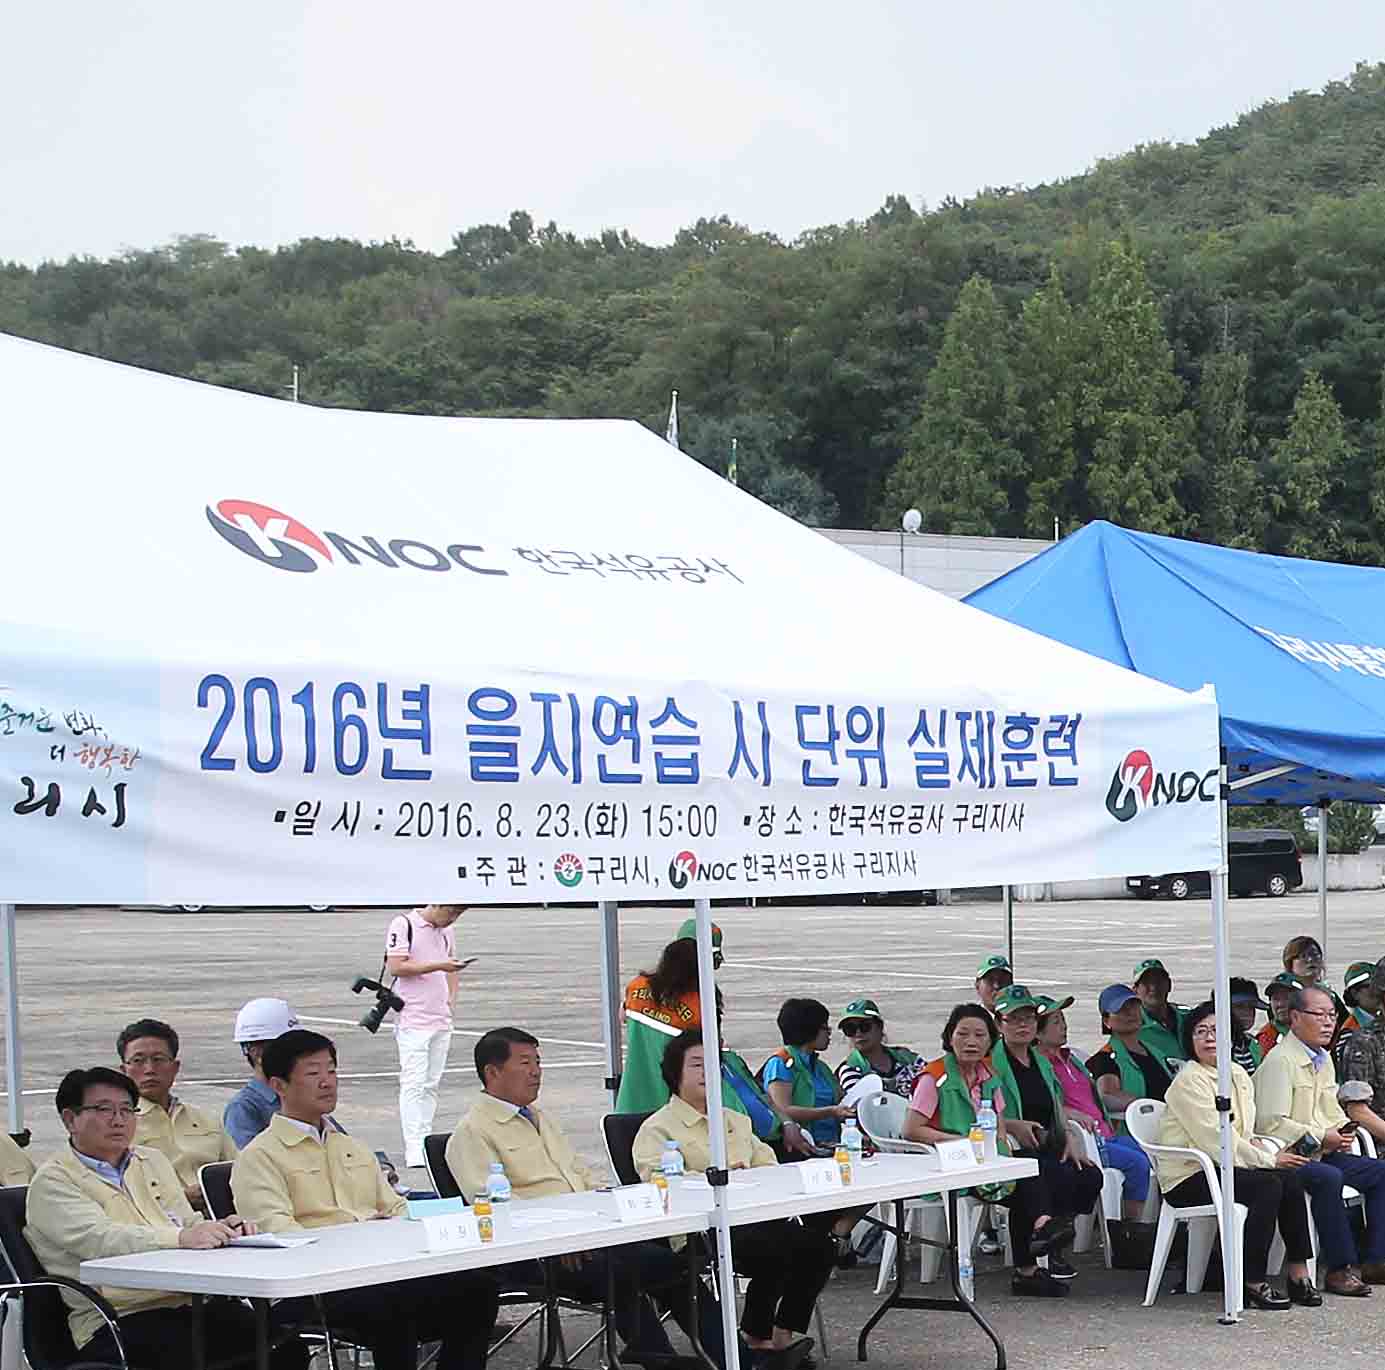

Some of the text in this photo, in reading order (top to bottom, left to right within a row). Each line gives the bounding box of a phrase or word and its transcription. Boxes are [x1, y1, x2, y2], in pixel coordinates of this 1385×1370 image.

[512, 546, 744, 584] 한국석유공사
[197, 673, 1083, 788] 2016년 을지연습 시 단위 실제훈련
[50, 744, 66, 762] 더
[1106, 749, 1220, 823] KNOC
[394, 802, 483, 838] 2016.
[495, 802, 522, 838] 8.
[535, 801, 629, 839] 23.(화)
[641, 803, 718, 839] 15:00
[828, 801, 945, 837] 한국석유공사
[952, 801, 1026, 835] 구리지사
[588, 855, 660, 888] 구리시,
[743, 852, 847, 883] 한국석유공사
[853, 850, 918, 877] 구리지사
